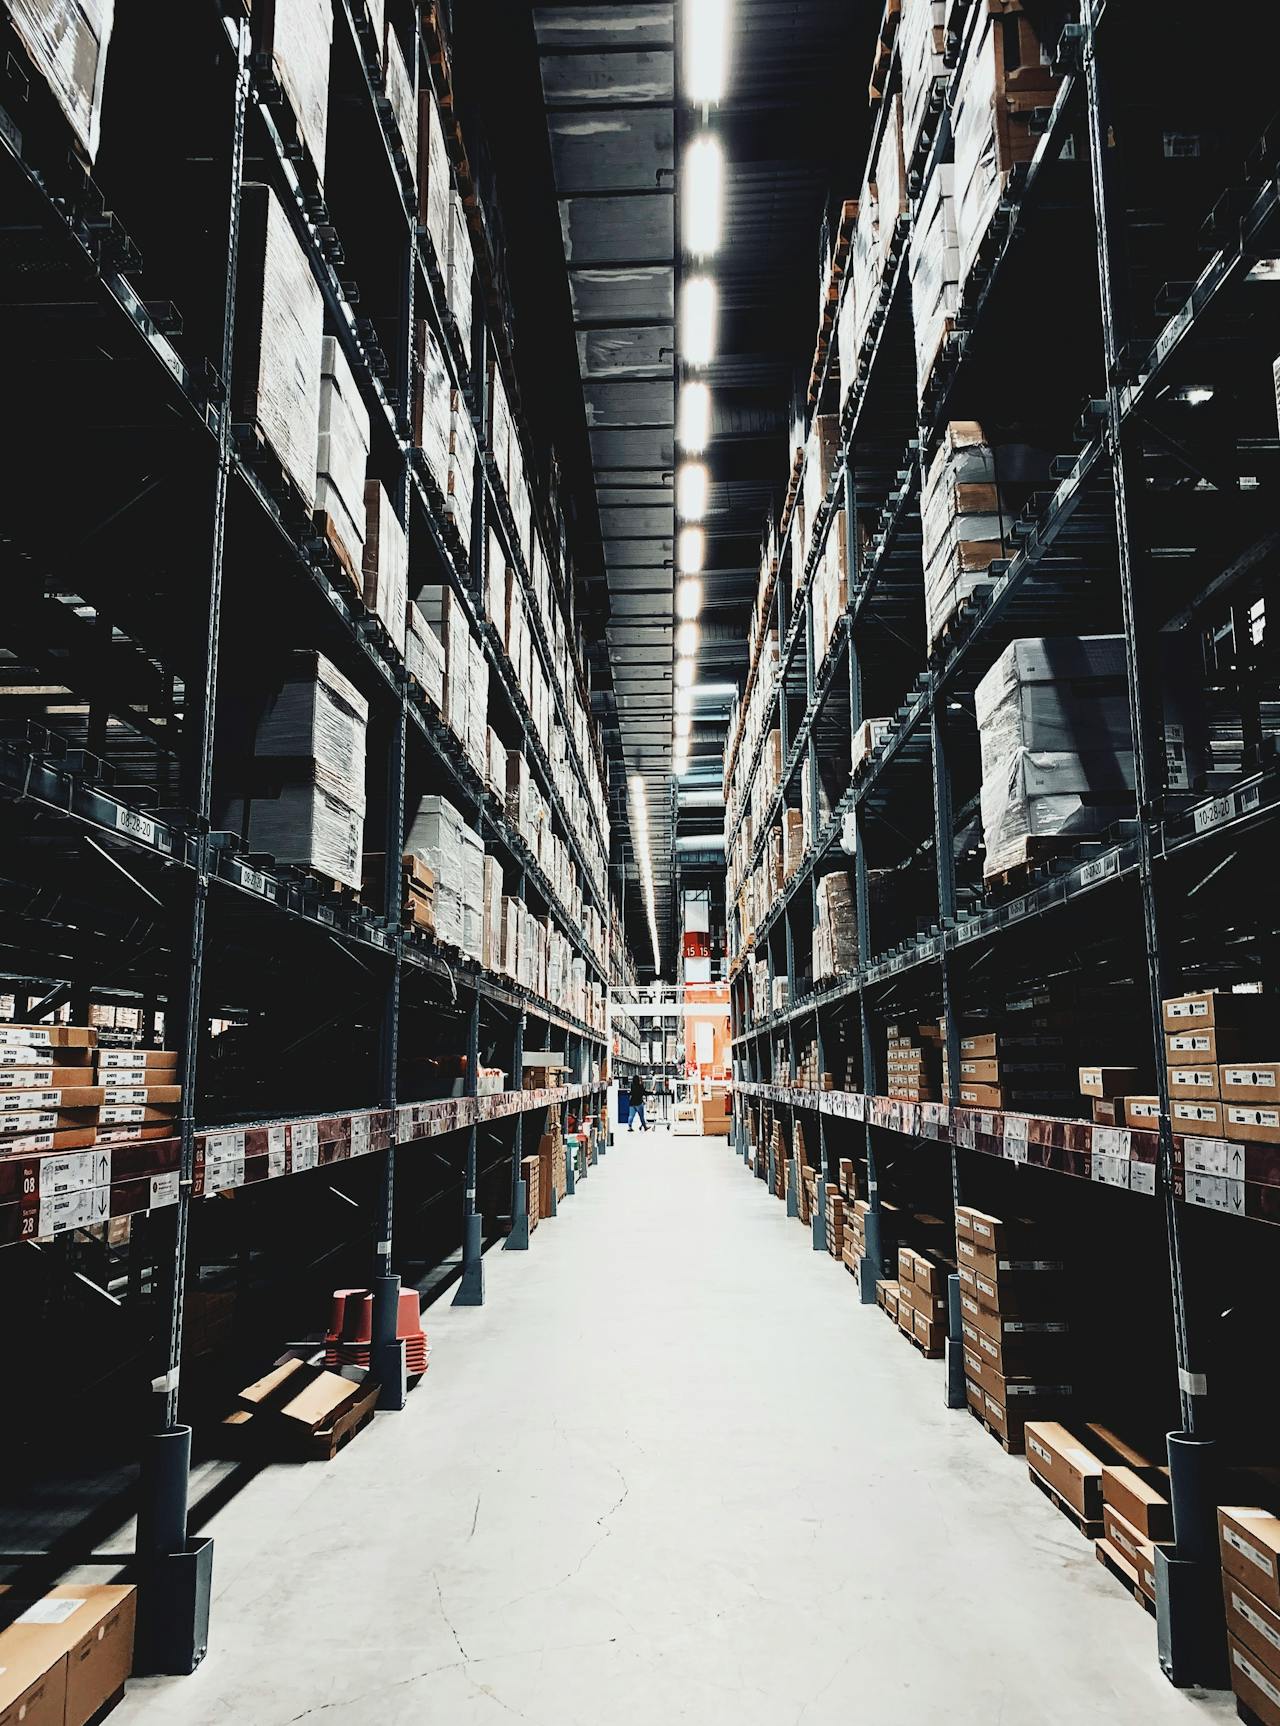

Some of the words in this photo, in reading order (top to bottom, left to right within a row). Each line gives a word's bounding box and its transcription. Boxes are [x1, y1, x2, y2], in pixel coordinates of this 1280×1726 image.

[1199, 801, 1230, 825] 10-28-20
[120, 811, 151, 838] 08-28-20
[687, 946, 696, 957] 15
[700, 946, 709, 957] 15
[1174, 1151, 1182, 1164] 10
[23, 1177, 36, 1194] 08
[1174, 1181, 1183, 1196] 28
[22, 1217, 35, 1235] 28
